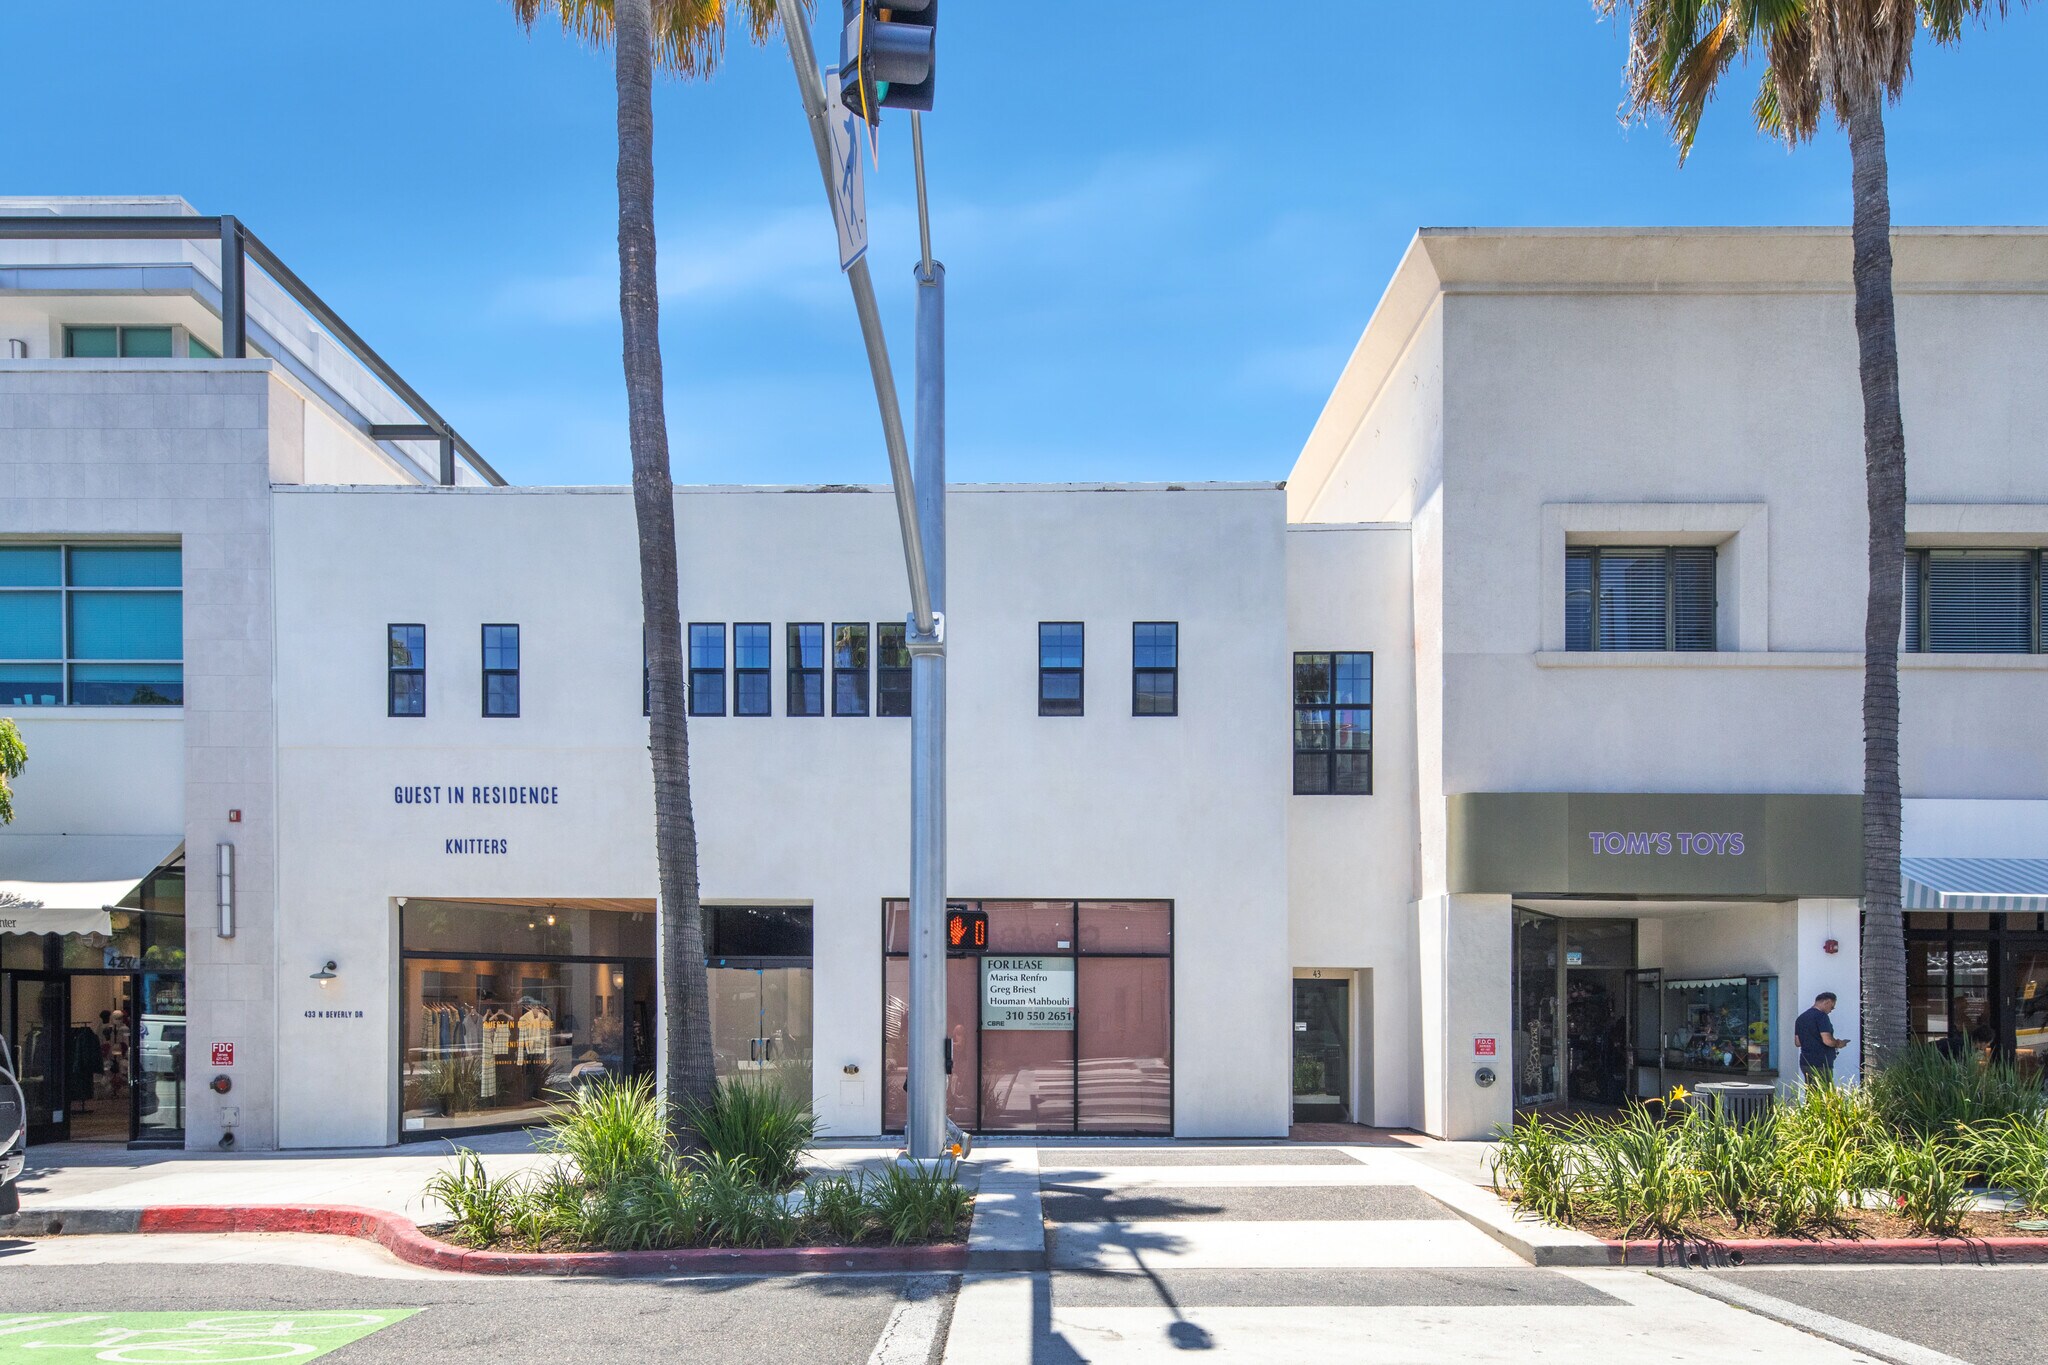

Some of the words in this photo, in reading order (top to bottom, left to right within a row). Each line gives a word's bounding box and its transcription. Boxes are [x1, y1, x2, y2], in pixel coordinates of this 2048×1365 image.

[394, 786, 441, 804] GUEST
[448, 786, 464, 804] IN
[472, 786, 558, 804] RESIDENCE
[445, 839, 507, 854] KNITTERS
[1589, 832, 1672, 855] TOM'S
[1677, 832, 1745, 855] TOYS
[988, 960, 1010, 970] FOR
[1012, 960, 1043, 970] LEASE
[990, 973, 1018, 982] Marisa
[1020, 973, 1048, 982] Renfro
[990, 985, 1011, 995] Greg
[1012, 985, 1036, 994] Briest
[990, 997, 1026, 1005] Houman
[1028, 997, 1070, 1006] Mahboubi
[304, 1010, 316, 1018] 433
[318, 1010, 323, 1018] N
[326, 1010, 352, 1019] BEVERLY
[354, 1010, 363, 1018] DR
[1005, 1011, 1024, 1021] 310
[1027, 1011, 1045, 1021] 550
[212, 1044, 232, 1052] FDC
